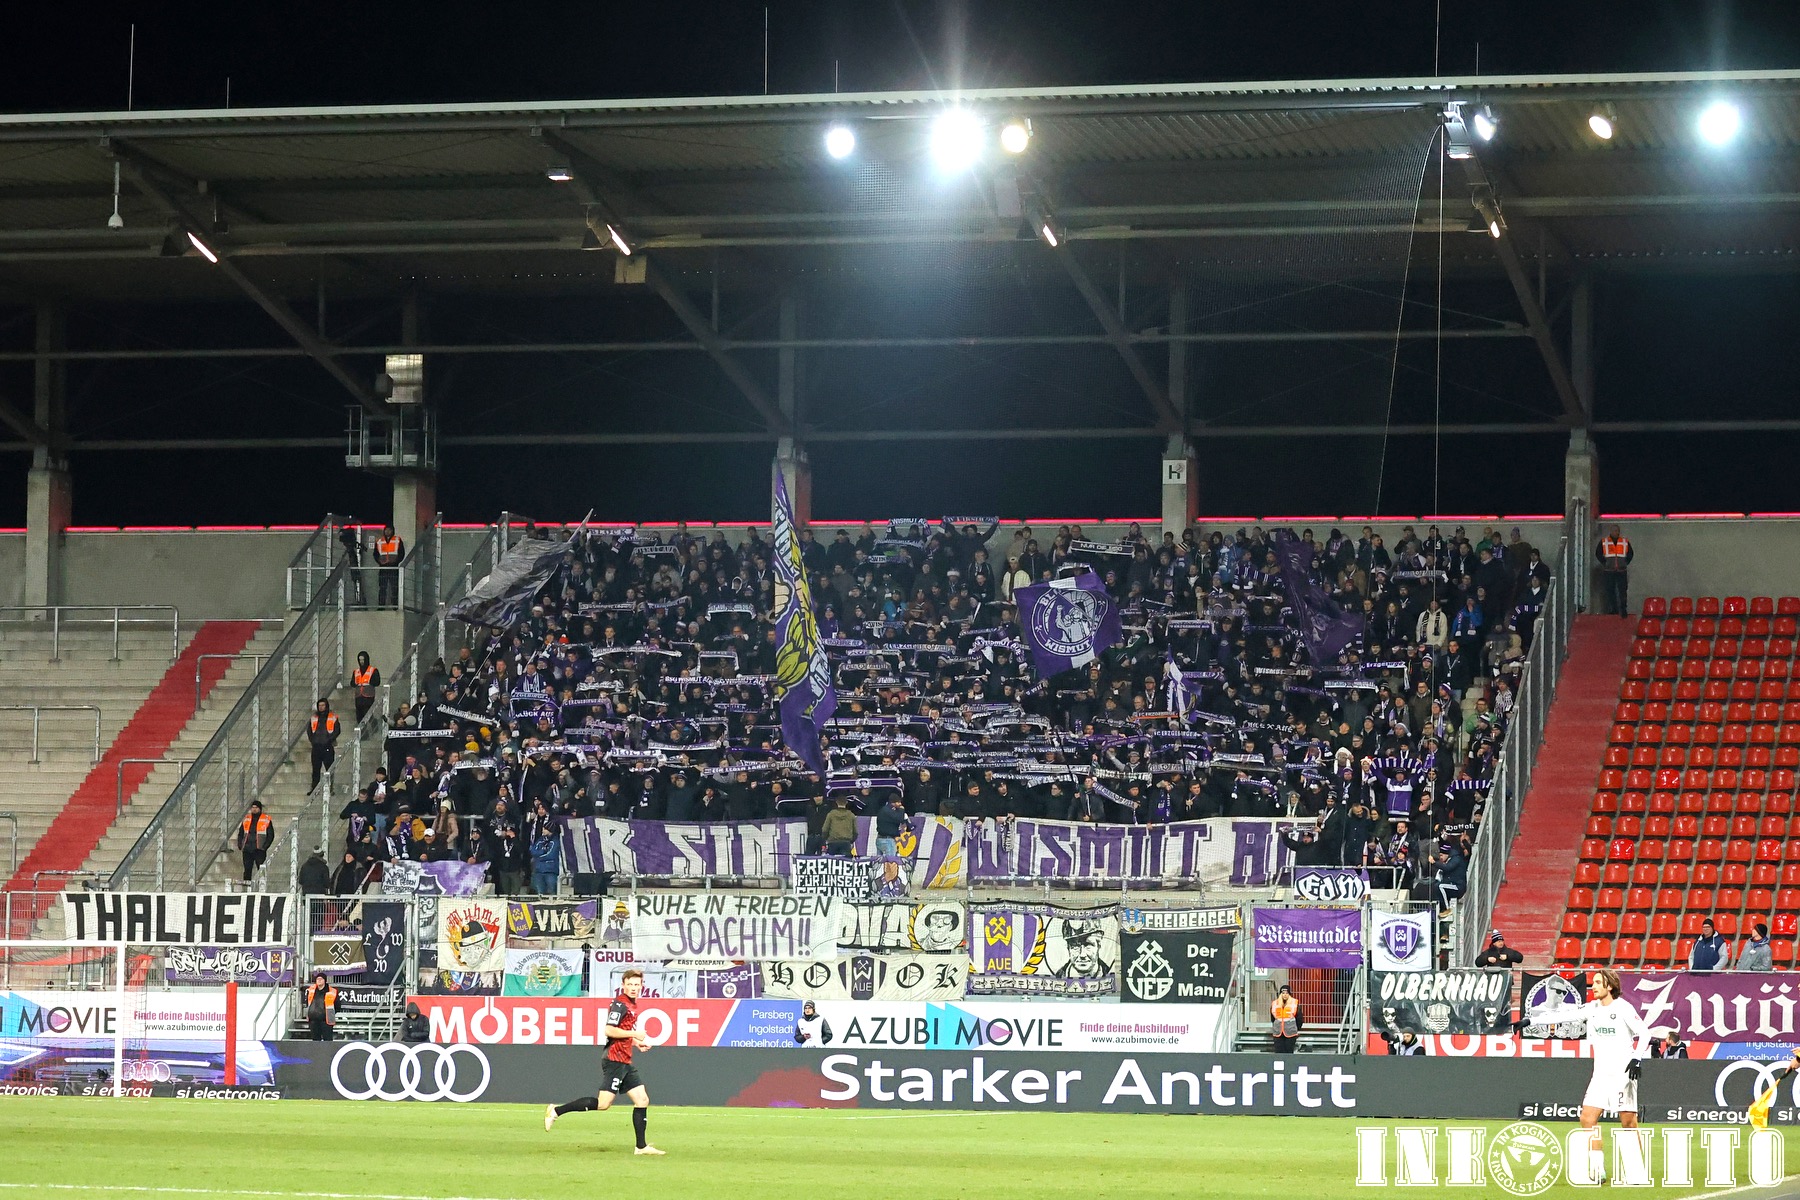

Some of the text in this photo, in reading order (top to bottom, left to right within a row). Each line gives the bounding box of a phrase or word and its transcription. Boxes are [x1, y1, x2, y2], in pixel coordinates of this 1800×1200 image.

[1045, 639, 1091, 654] WISMUT
[796, 859, 870, 876] FREIHEIT
[821, 875, 869, 888] UNSERE
[637, 895, 831, 918] RUHE IN FRIEDEN
[66, 894, 287, 943] THALHEIM
[1145, 909, 1236, 927] FREIBERGER
[664, 916, 812, 957] JOACHIM!!
[1187, 944, 1218, 958] Der
[987, 958, 1012, 971] AUE
[1191, 963, 1214, 978] 12.
[852, 982, 873, 992] AUE
[971, 976, 1113, 993] ERZBRIGADE
[1178, 983, 1225, 998] Mann
[1381, 973, 1503, 1002] OLBERNHAU
[18, 1006, 116, 1034] MOVIE
[134, 1011, 227, 1022] Finde deine Ausbildun
[752, 1010, 794, 1022] Parsberg
[144, 1023, 226, 1032] www.azubimovie.de
[748, 1024, 794, 1035] Ingolstadt
[843, 1017, 1063, 1047] AZUBI MOVIE
[1080, 1022, 1190, 1036] Finde deine Ausbildung!
[730, 1039, 794, 1048] moebelhof.de
[1091, 1035, 1180, 1045] www.azubimovie.de
[820, 1054, 1357, 1108] Starker Antritt
[82, 1085, 96, 1097] si
[176, 1086, 281, 1101] si electronics
[1523, 1103, 1539, 1117] si
[1667, 1107, 1749, 1123] si energy
[1778, 1107, 1793, 1121] si
